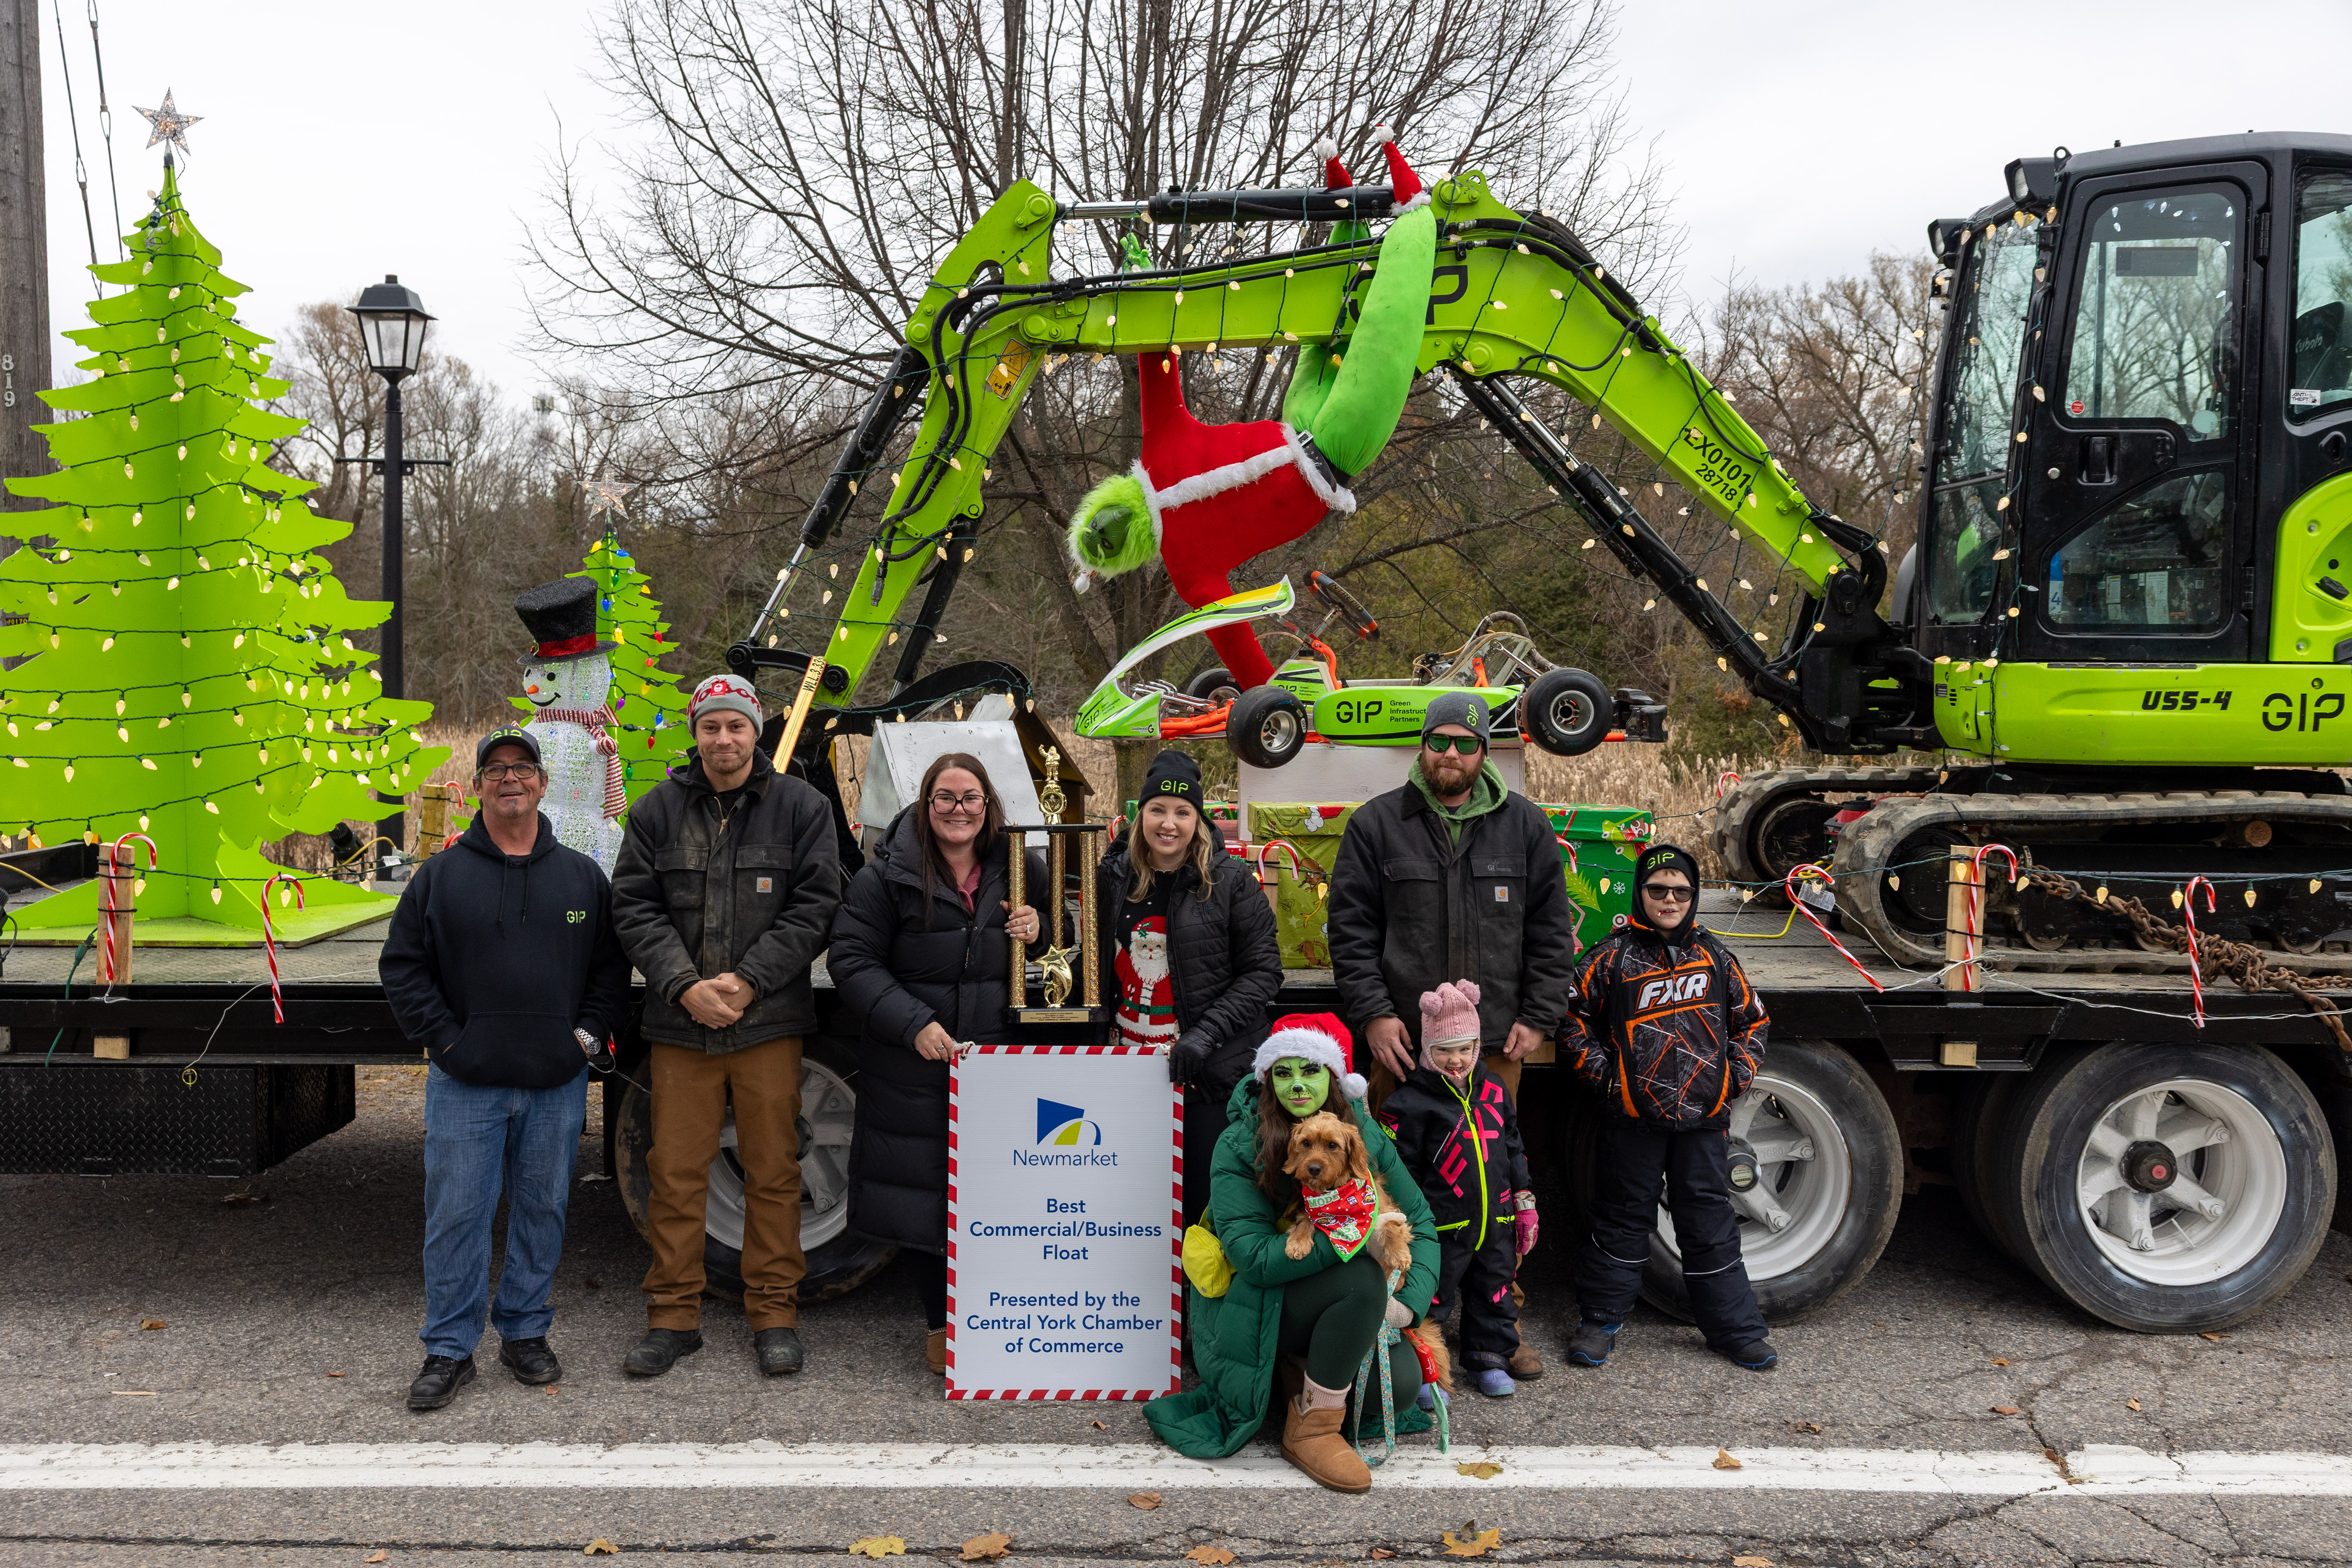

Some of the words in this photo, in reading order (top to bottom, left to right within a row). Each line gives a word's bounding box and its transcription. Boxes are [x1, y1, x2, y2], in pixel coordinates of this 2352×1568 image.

[2, 355, 15, 407] 819
[1683, 426, 1752, 489] EX0101
[1695, 463, 1738, 502] 28718
[1329, 582, 1363, 612] INTREPID
[1084, 709, 1100, 729] GIP
[1336, 701, 1382, 723] GIP
[1467, 704, 1479, 726] GIP
[2262, 693, 2345, 732] GIP
[1161, 780, 1188, 793] GIP
[1647, 852, 1675, 870] GIP
[567, 911, 586, 923] GIP
[1191, 901, 1217, 917] GIP
[1638, 973, 1708, 1009] FXR
[1385, 1127, 1393, 1139] FXR
[1014, 1149, 1118, 1166] Newmarket
[1047, 1198, 1086, 1213] Best
[1308, 1195, 1339, 1207] MODE
[970, 1221, 1162, 1238] Commercial/Business
[1043, 1244, 1089, 1260] Float
[990, 1291, 1078, 1307] Presented
[1085, 1291, 1106, 1311] by
[1112, 1291, 1140, 1307] the
[967, 1314, 1031, 1330] Central
[1037, 1314, 1076, 1329] York
[1082, 1314, 1163, 1330] Chamber
[1005, 1337, 1024, 1353] of
[1029, 1338, 1124, 1353] Commerce
